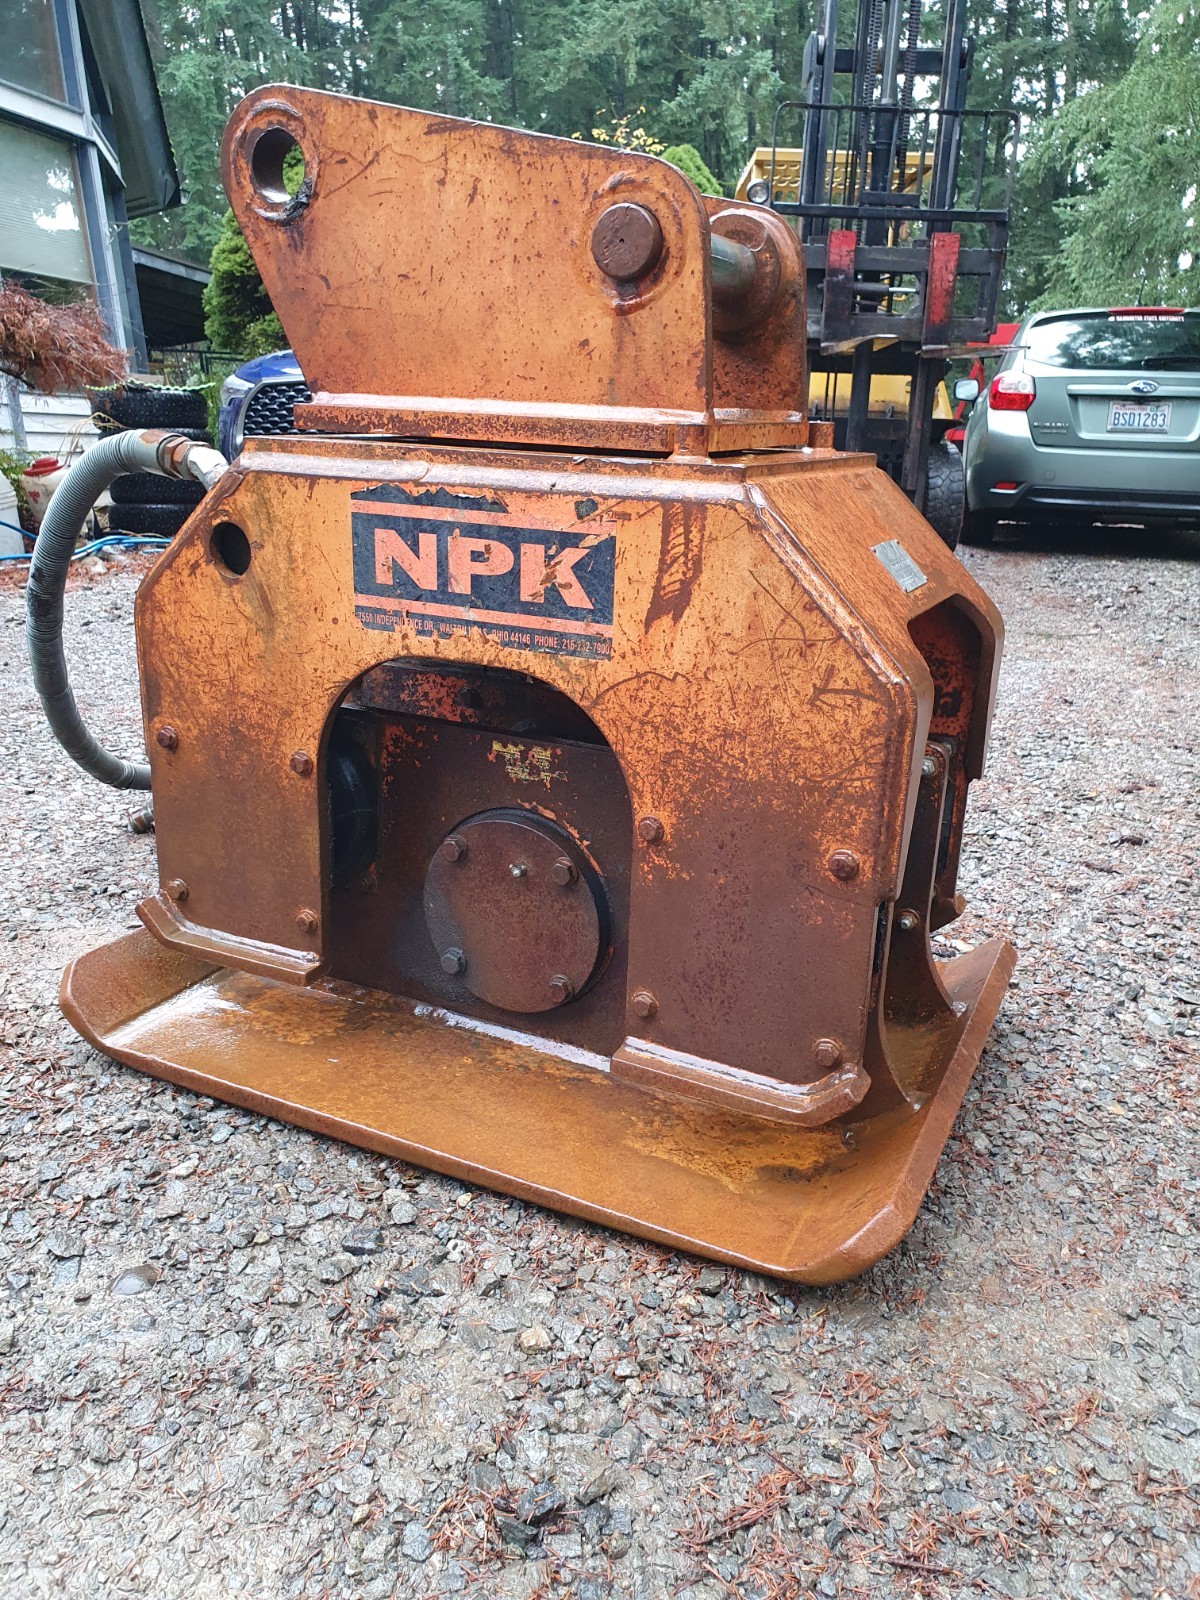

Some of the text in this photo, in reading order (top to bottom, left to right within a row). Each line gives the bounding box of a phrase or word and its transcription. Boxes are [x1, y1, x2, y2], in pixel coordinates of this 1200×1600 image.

[1112, 411, 1167, 427] BSD1283
[374, 528, 594, 610] NPK
[510, 632, 531, 645] 44146
